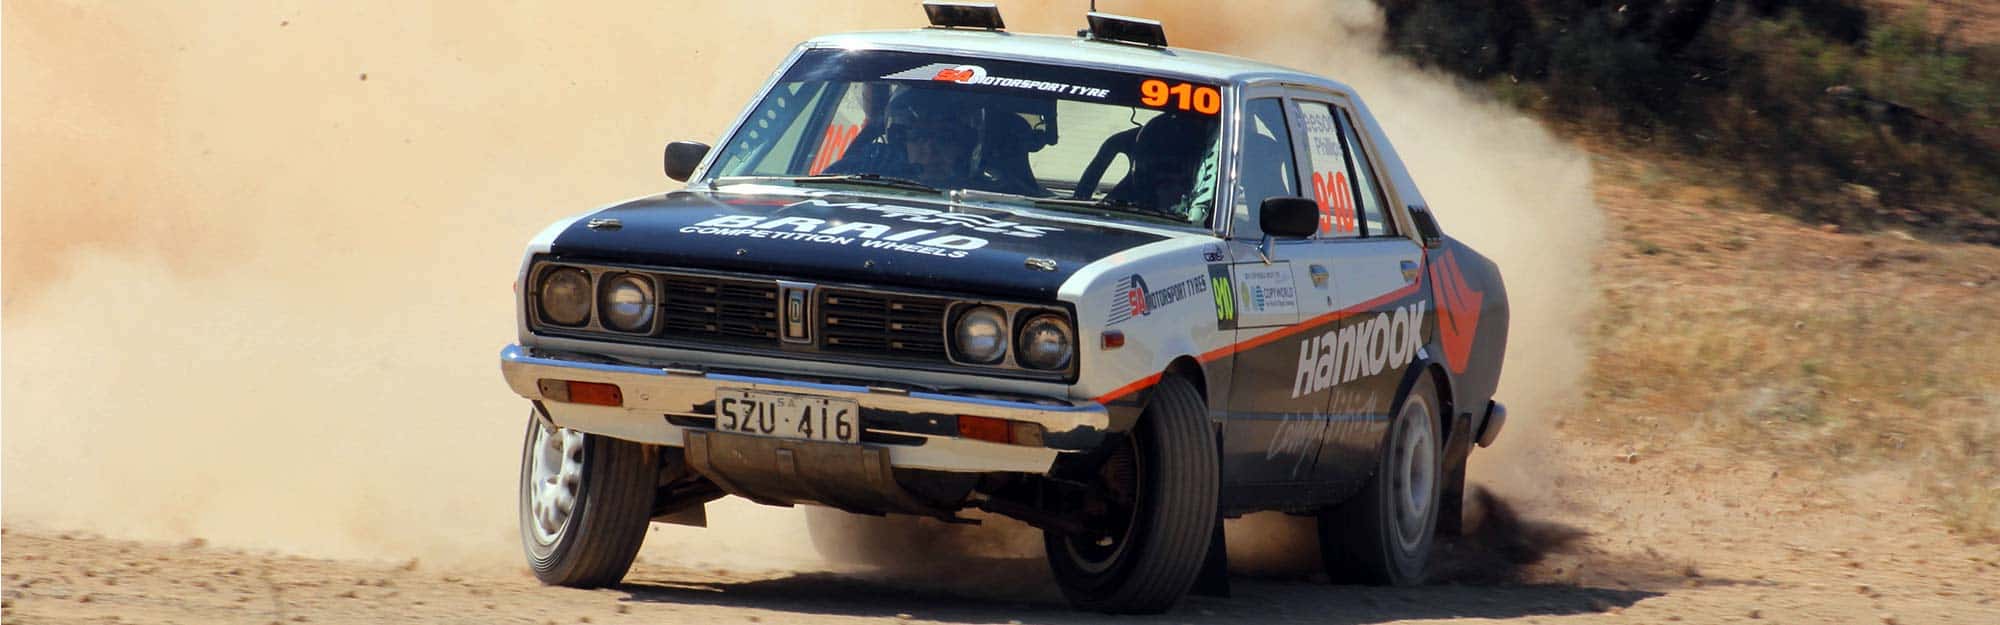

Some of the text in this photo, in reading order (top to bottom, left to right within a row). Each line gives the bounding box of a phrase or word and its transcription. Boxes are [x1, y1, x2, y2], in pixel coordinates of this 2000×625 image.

[1069, 85, 1110, 98] TYRE
[1141, 79, 1221, 115] 910
[1312, 171, 1354, 233] 910
[680, 226, 969, 259] COMPETITION WHEELS
[694, 213, 989, 251] BRAID
[1187, 274, 1207, 297] TYRES
[1211, 276, 1233, 321] 910
